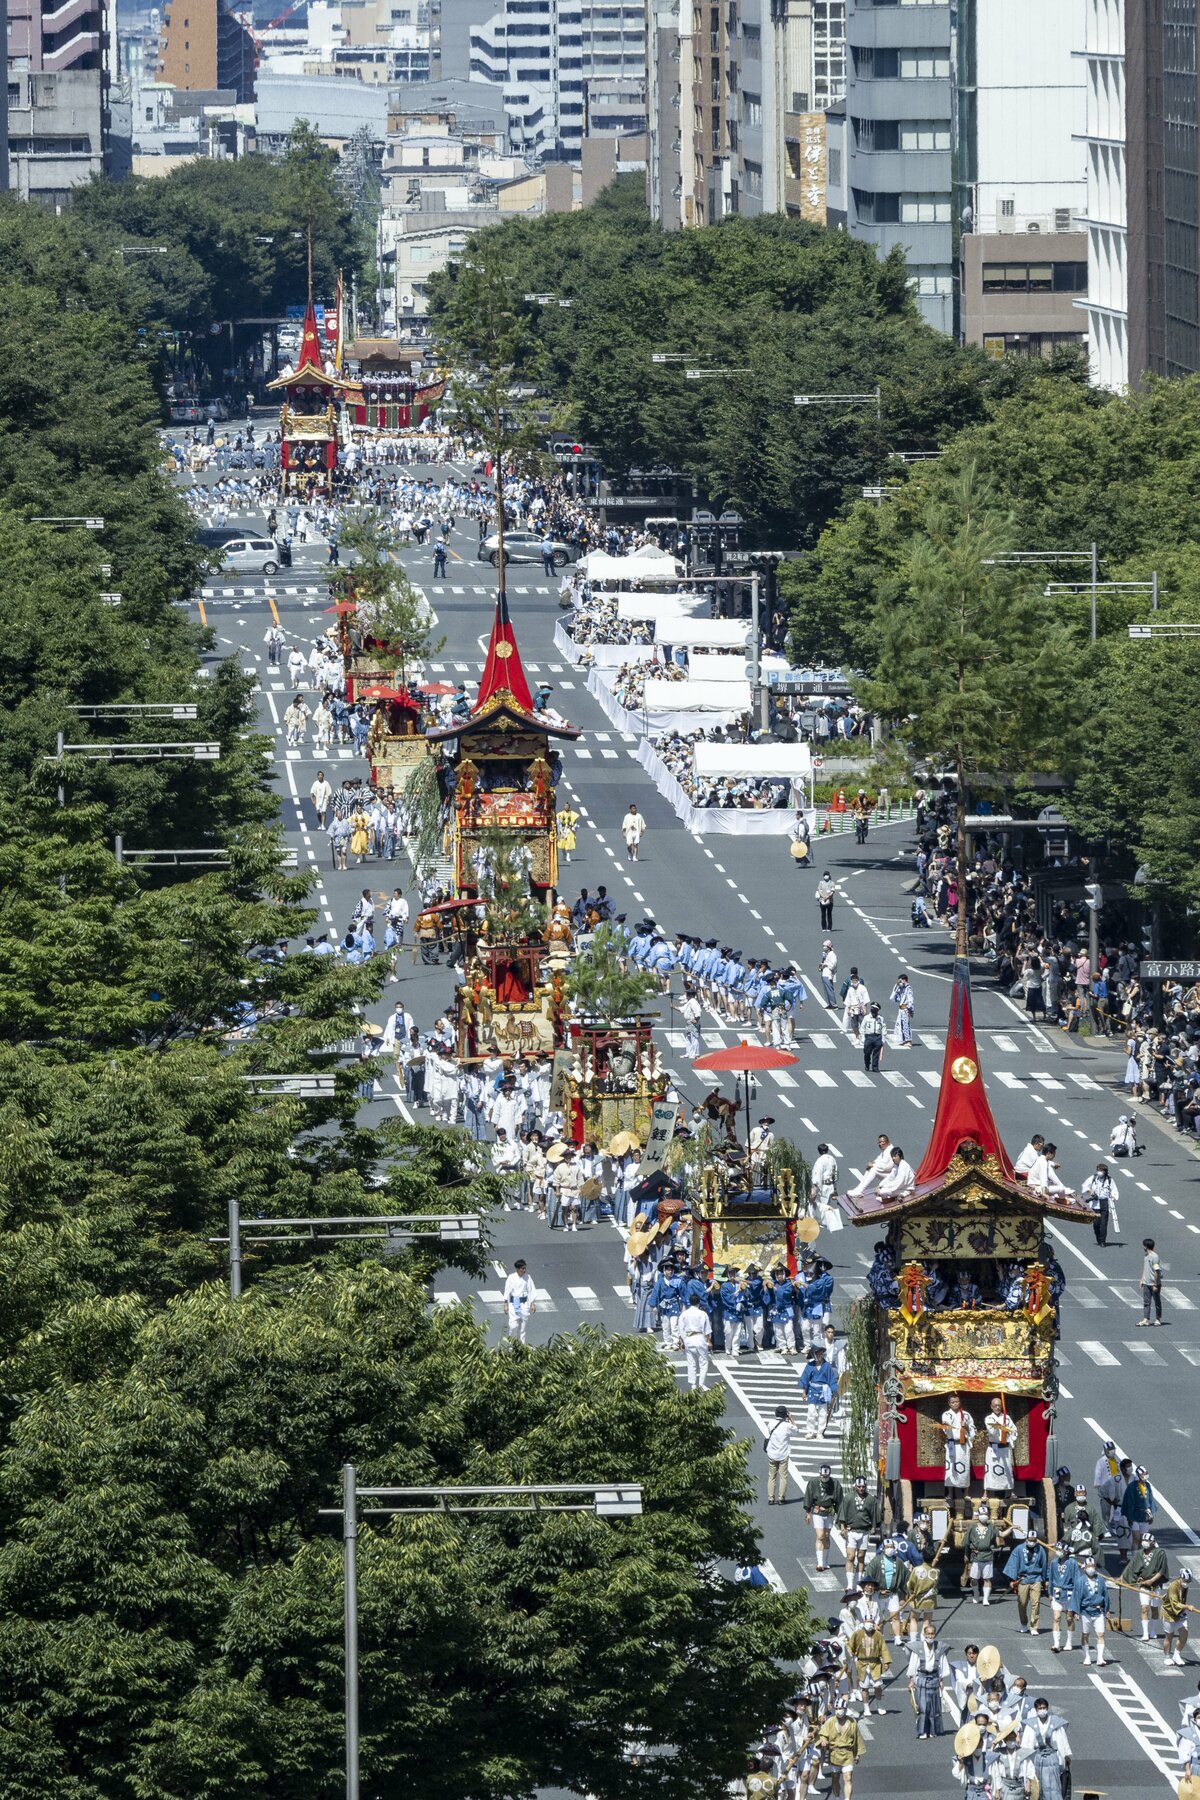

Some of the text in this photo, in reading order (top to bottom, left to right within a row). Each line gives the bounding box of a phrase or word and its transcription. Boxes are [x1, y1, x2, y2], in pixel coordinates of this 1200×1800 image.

[777, 683, 823, 692] 堺町通
[646, 1126, 668, 1162] 鯉山
